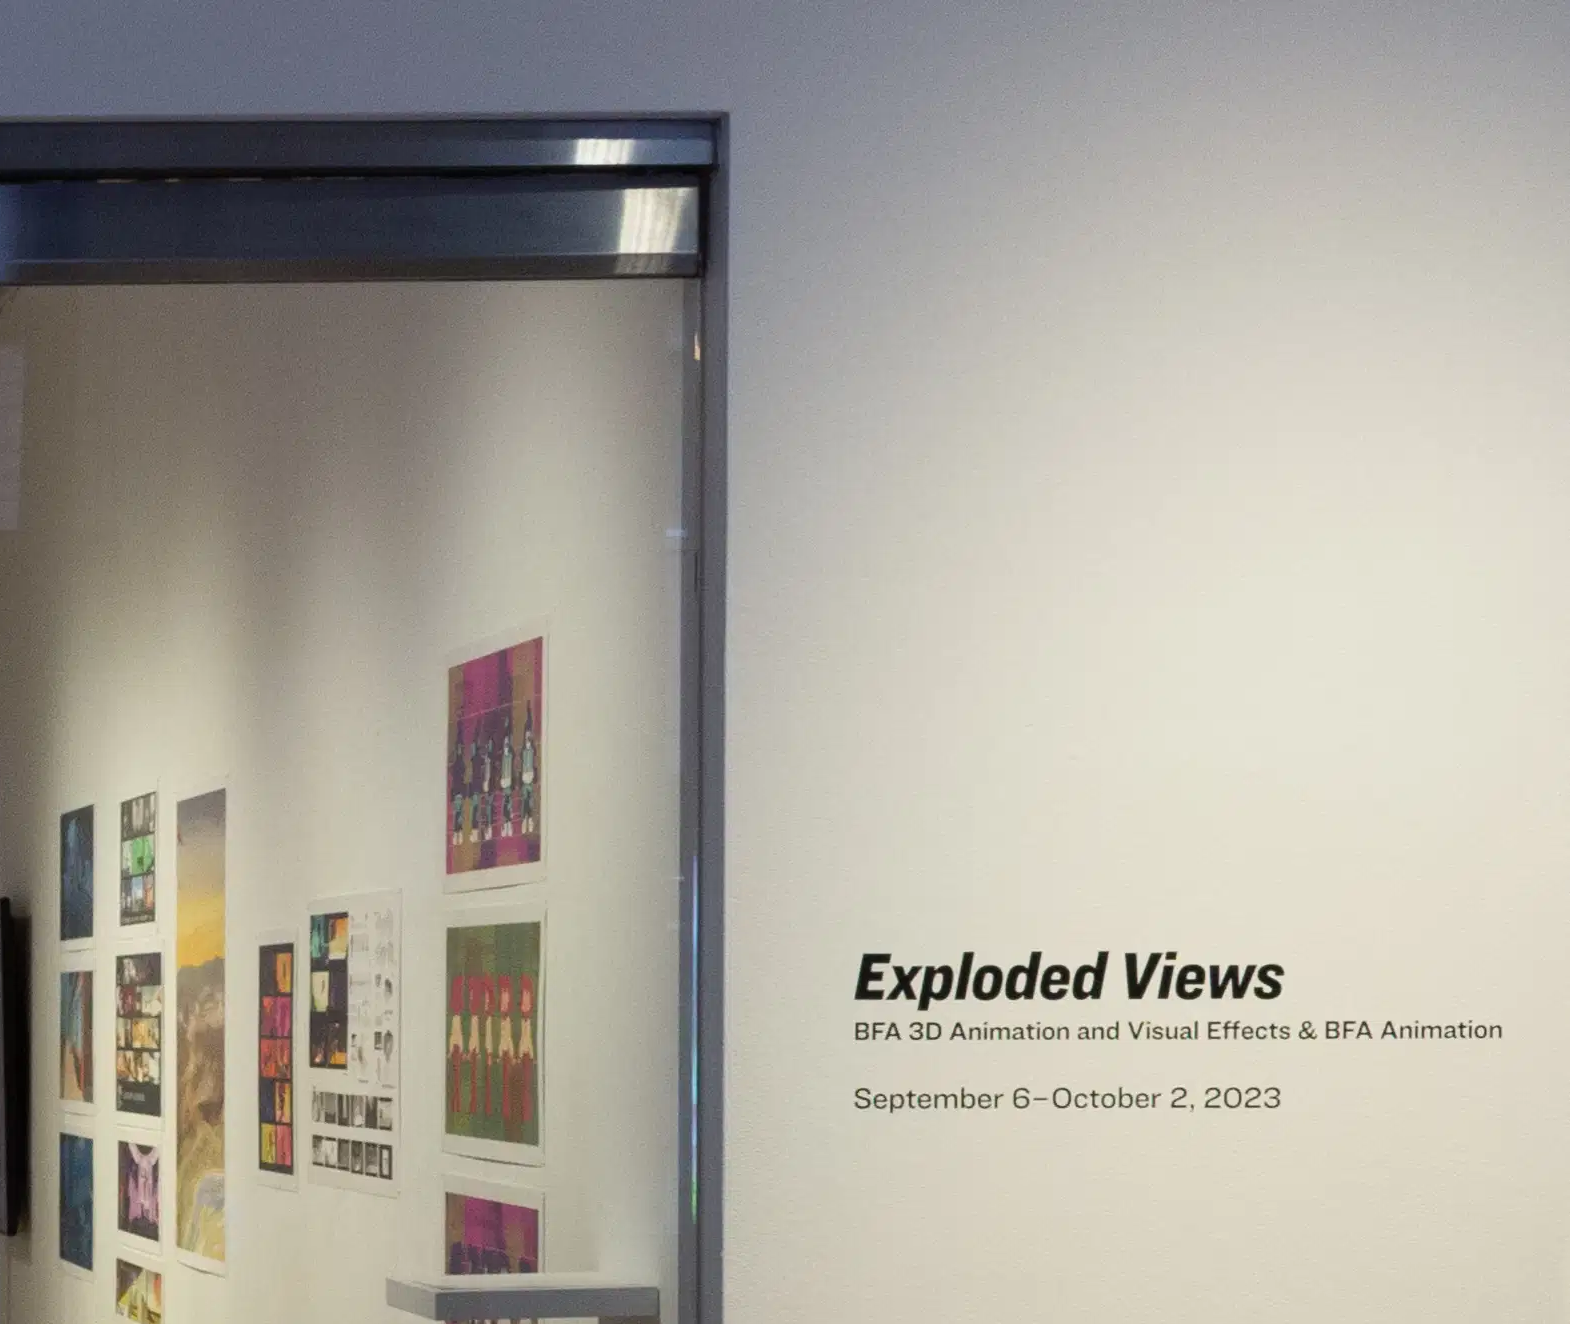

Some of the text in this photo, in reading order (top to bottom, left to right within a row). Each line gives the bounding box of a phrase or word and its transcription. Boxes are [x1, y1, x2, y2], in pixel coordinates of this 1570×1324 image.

[854, 950, 1285, 1012] Exploded Views
[854, 1019, 1503, 1041] BFA 3D Animation and Visual Effects & BFA Animation
[854, 1086, 1005, 1116] September
[1170, 1087, 1196, 1113] 2,
[1204, 1086, 1282, 1110] 2023
